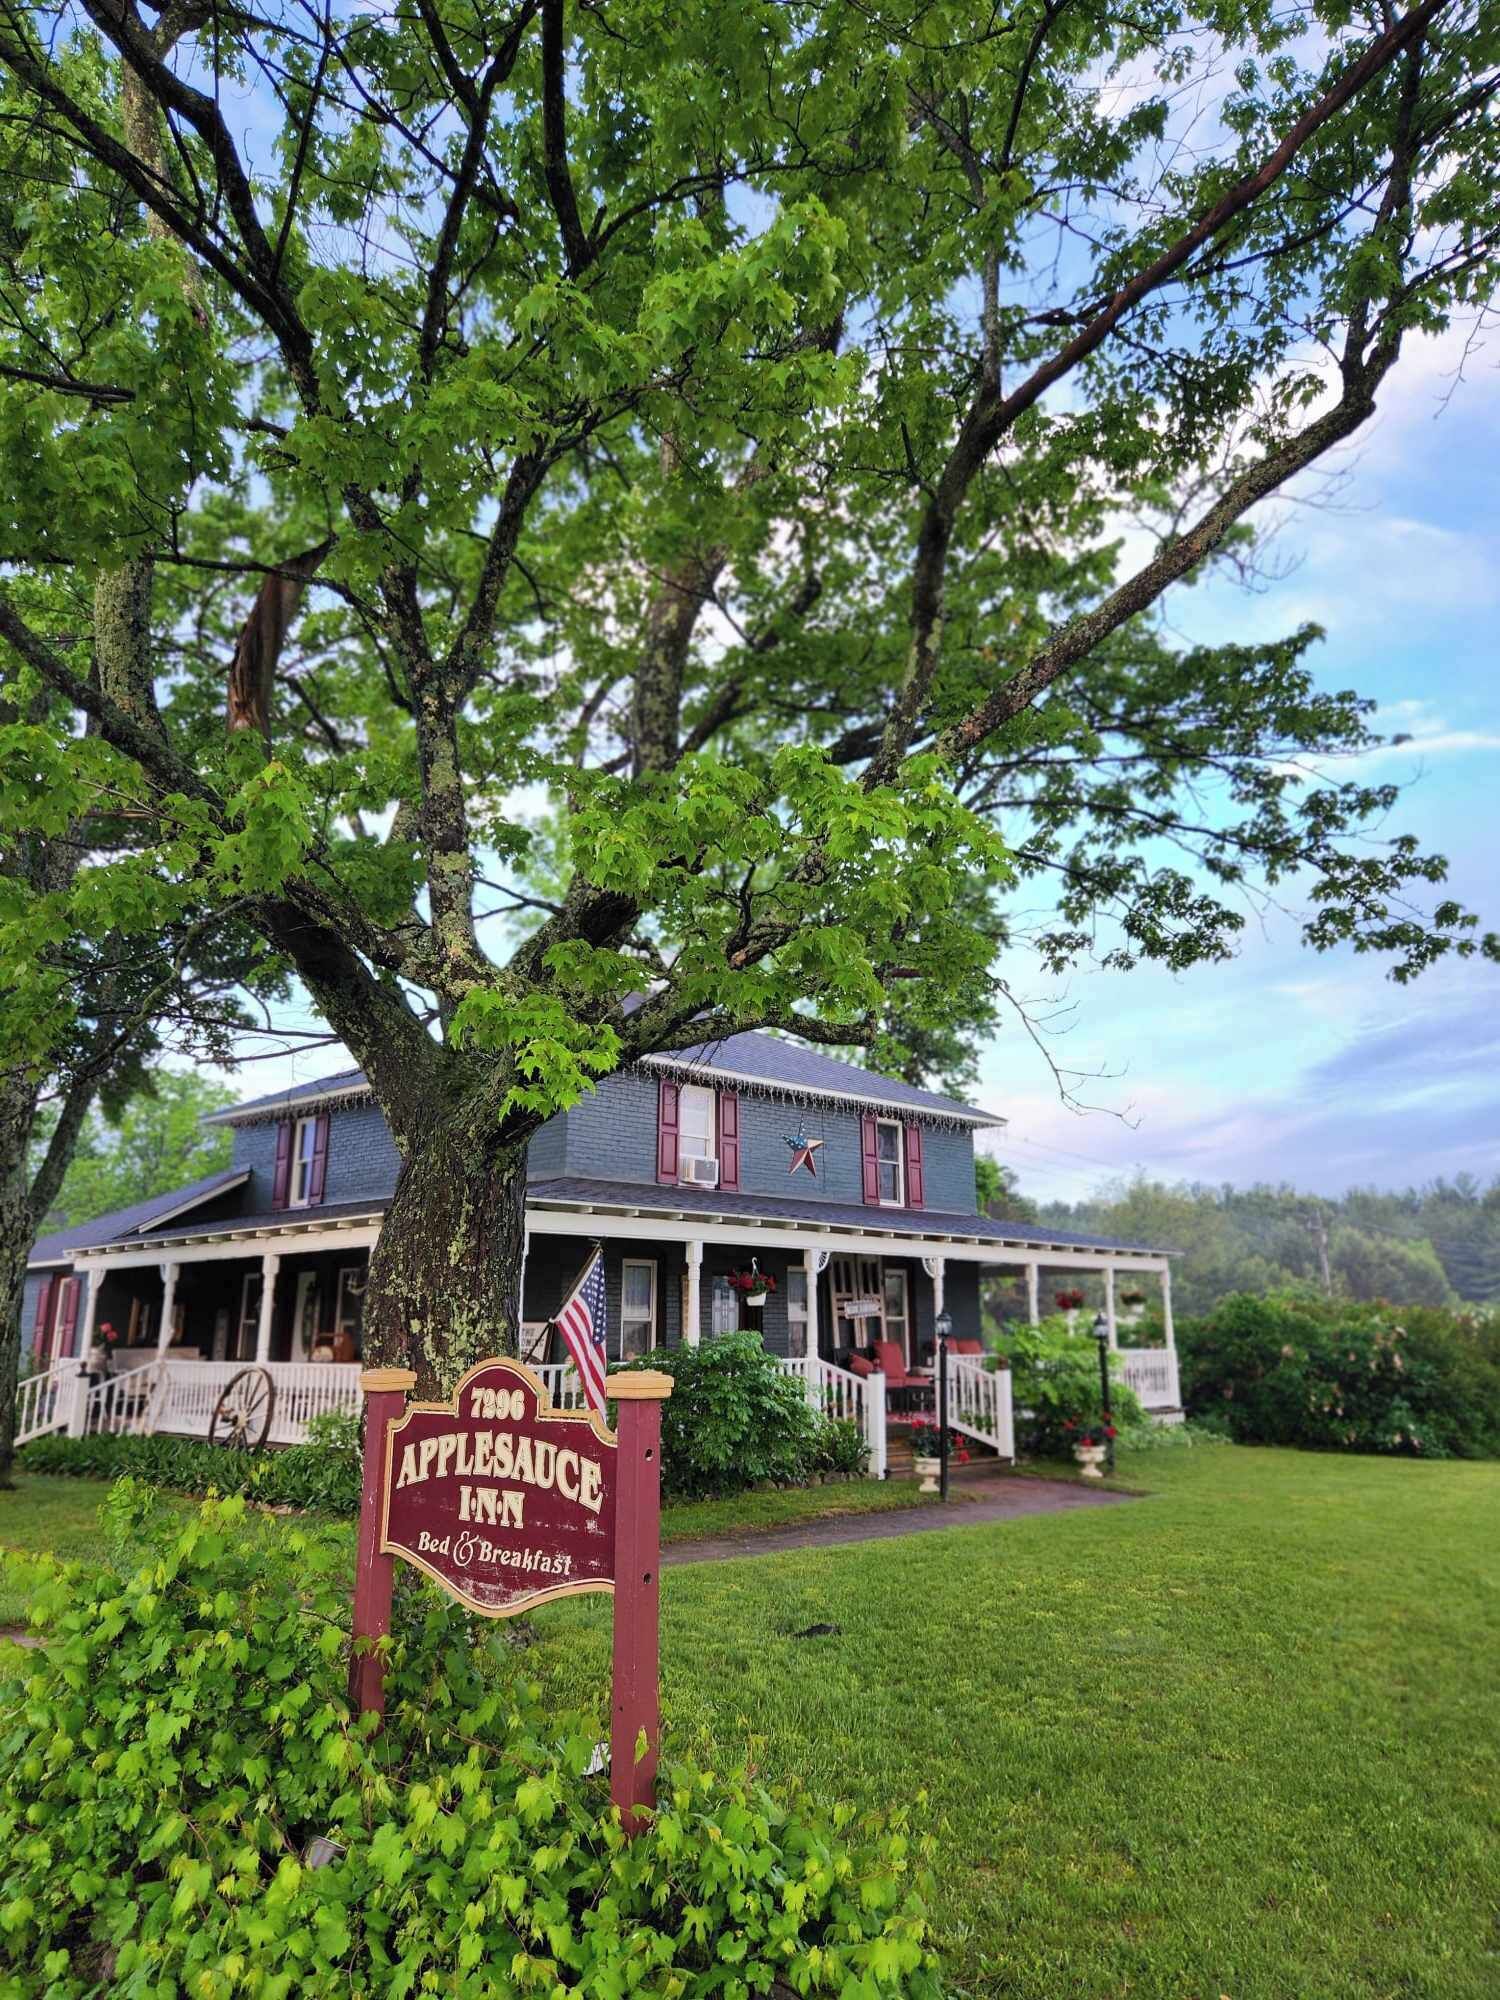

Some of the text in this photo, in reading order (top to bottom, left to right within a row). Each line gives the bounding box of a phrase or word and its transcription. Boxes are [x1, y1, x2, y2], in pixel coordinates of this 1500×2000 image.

[471, 1387, 525, 1420] 7296
[396, 1430, 603, 1514] APPLESAUCE
[418, 1531, 572, 1575] Bed & Breakfast
